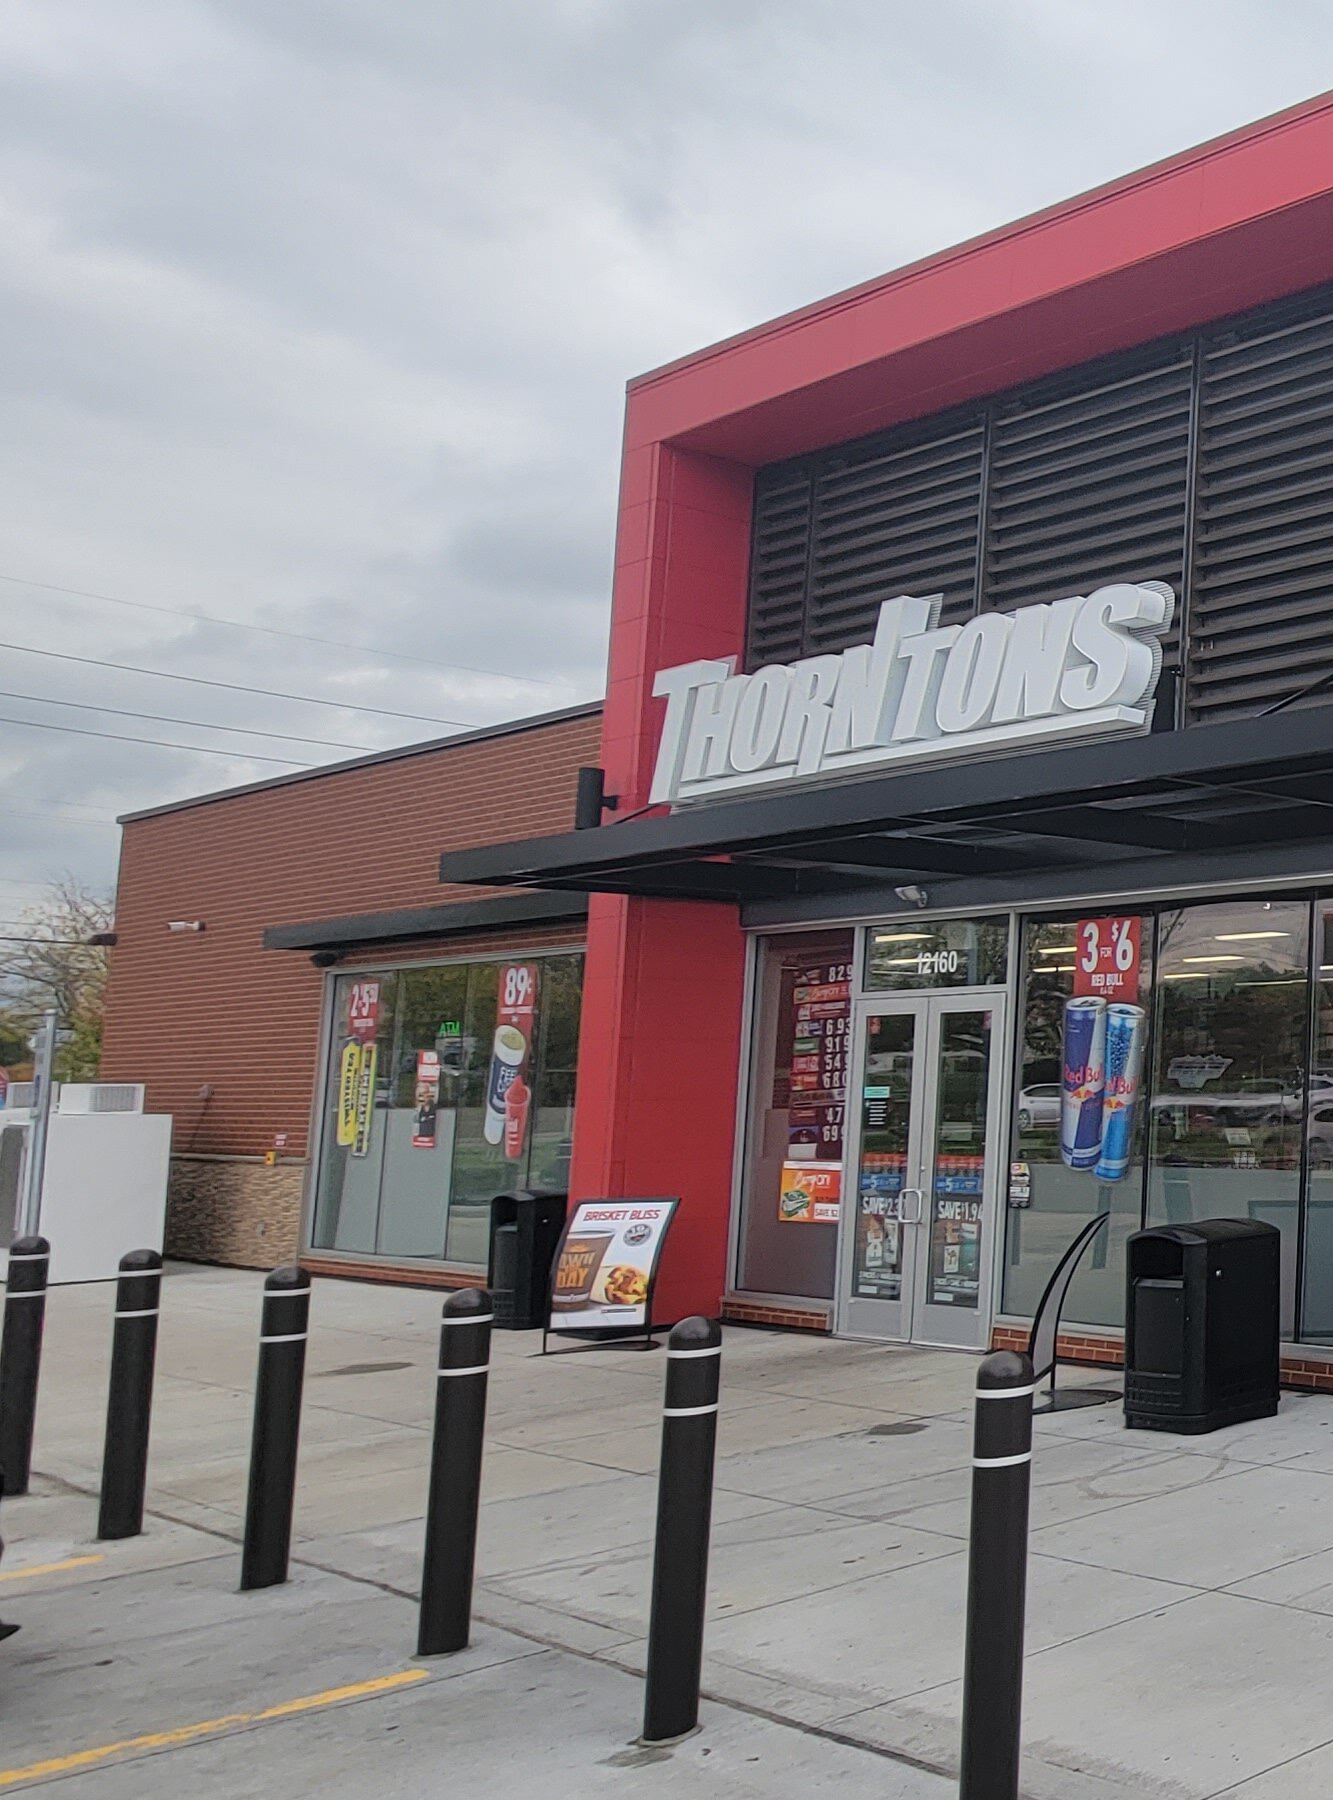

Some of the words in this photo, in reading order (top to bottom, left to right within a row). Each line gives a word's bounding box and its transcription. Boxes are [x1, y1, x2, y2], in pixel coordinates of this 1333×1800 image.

[1081, 922, 1099, 972] 3
[1100, 947, 1112, 958] FOR
[917, 951, 958, 974] 12160
[1091, 974, 1105, 986] RED
[1106, 973, 1123, 986] BULL
[440, 1021, 460, 1036] ATM
[1064, 1064, 1084, 1083] Red
[583, 1210, 629, 1221] BRISKET
[629, 1209, 661, 1220] BLISS
[862, 1197, 885, 1215] SAVE
[938, 1201, 961, 1219] SAVE
